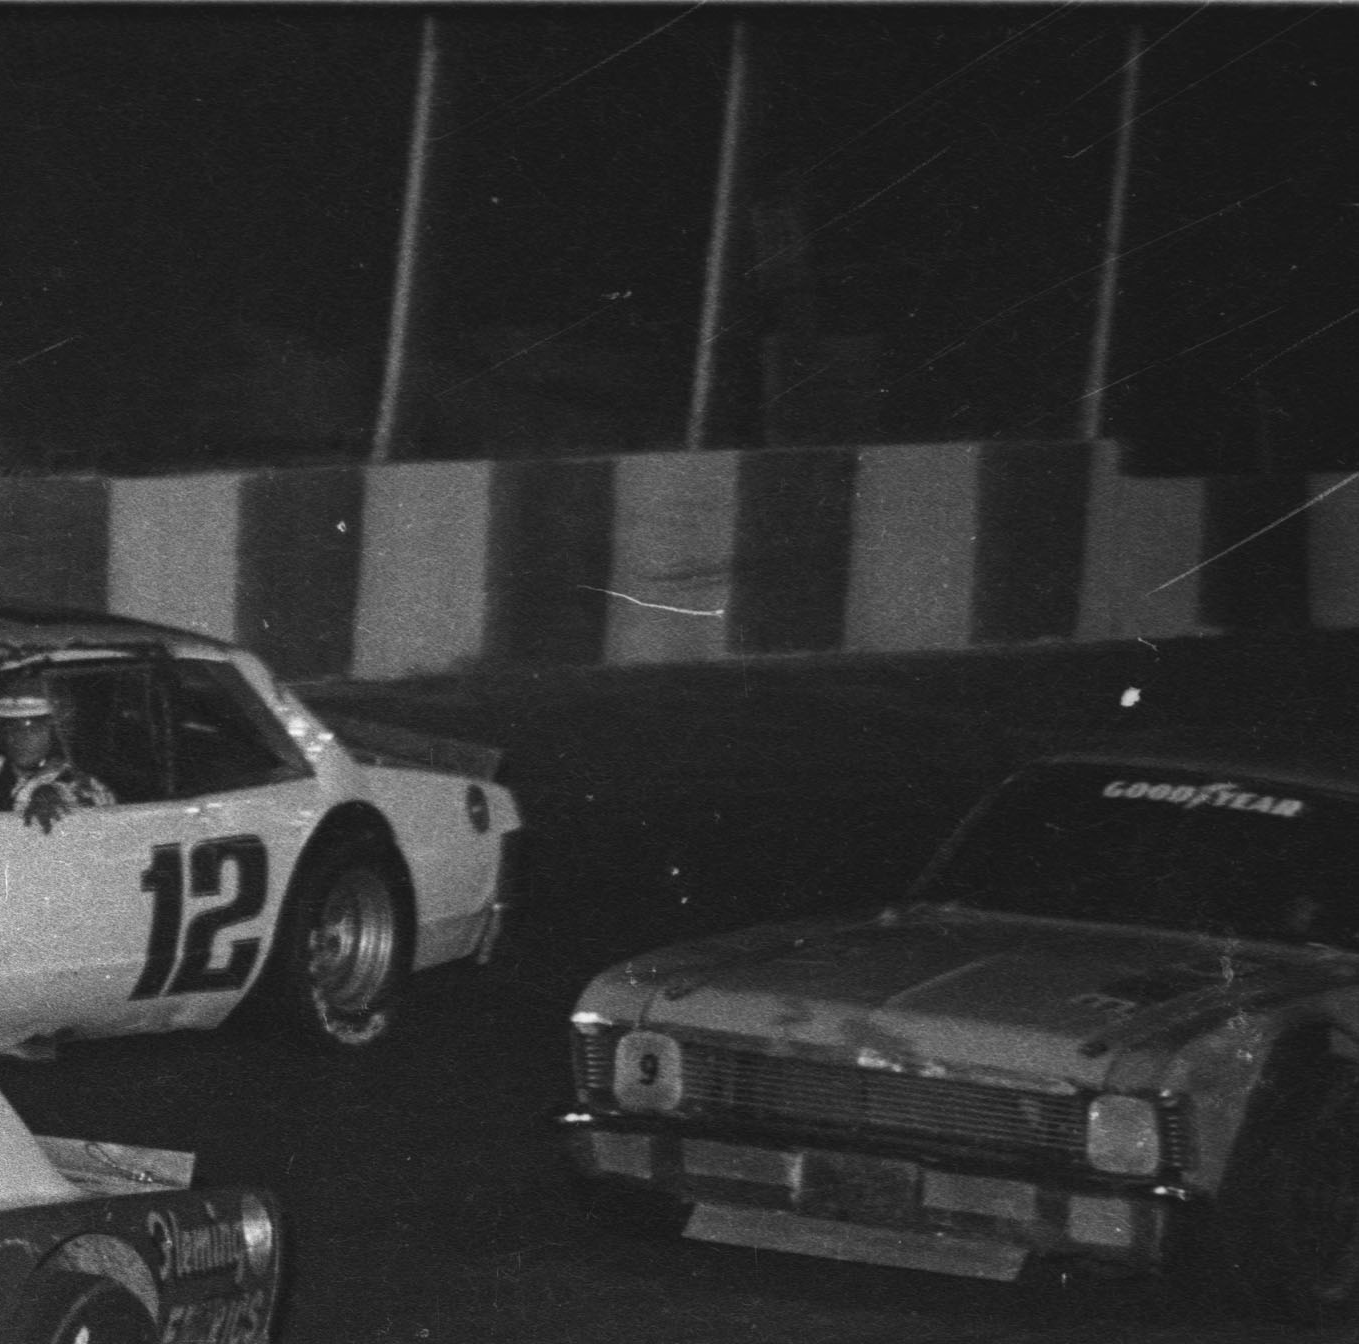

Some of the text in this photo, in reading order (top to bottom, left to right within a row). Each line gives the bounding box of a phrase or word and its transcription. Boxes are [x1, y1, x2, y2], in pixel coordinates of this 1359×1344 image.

[1102, 780, 1306, 819] GOODYEAR
[127, 834, 269, 1001] 12
[639, 1053, 660, 1087] 9
